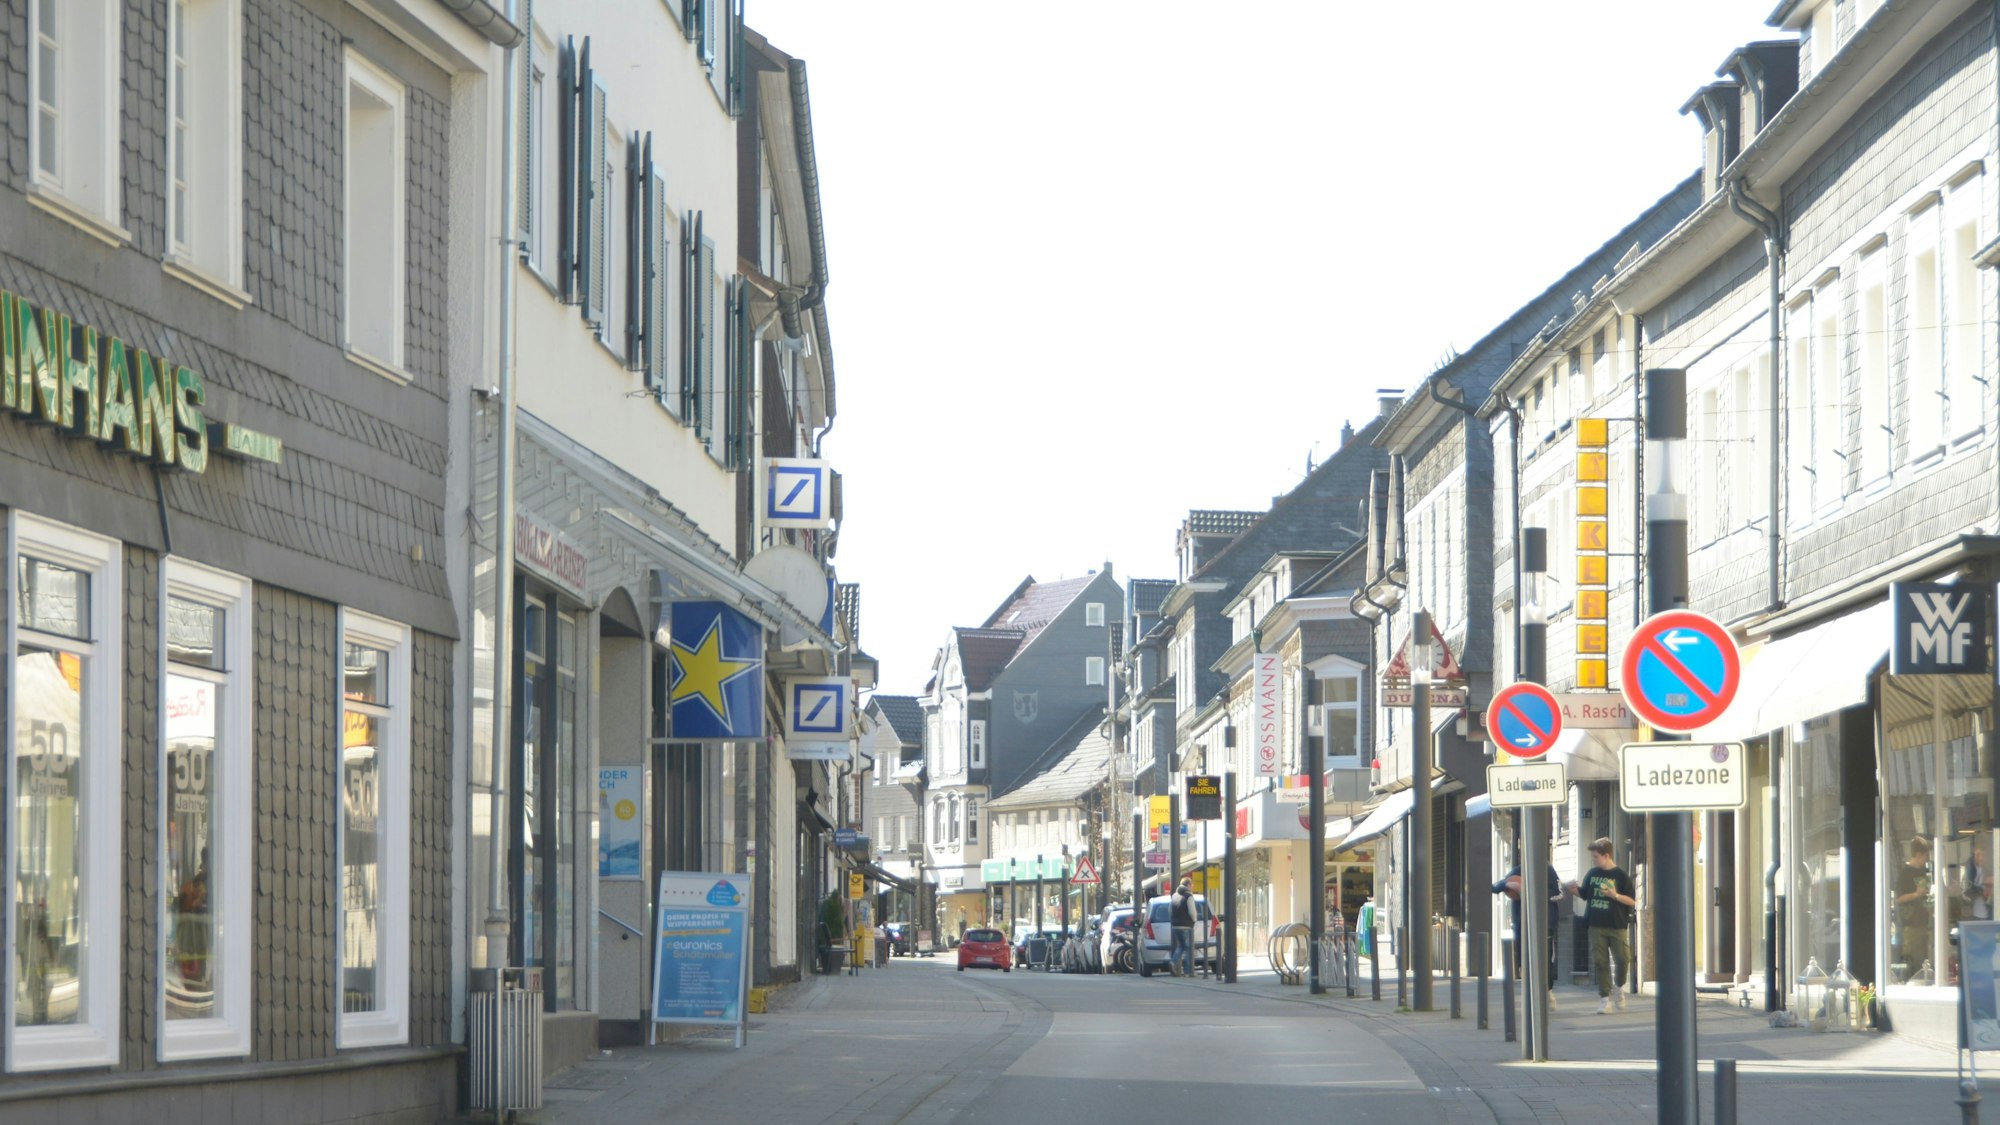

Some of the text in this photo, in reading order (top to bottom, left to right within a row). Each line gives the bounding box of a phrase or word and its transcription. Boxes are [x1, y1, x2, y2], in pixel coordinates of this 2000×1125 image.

[1582, 420, 1604, 687] ÄCKEREI
[1908, 592, 1971, 664] WMF
[1387, 694, 1462, 703] DUNA
[1260, 657, 1275, 773] ROSSMANN
[1562, 703, 1627, 719] A. Rasch
[30, 719, 68, 773] 50
[175, 743, 207, 791] 50
[1636, 764, 1730, 787] Ladezone
[31, 778, 67, 796] Jahre
[1189, 786, 1217, 795] FAHREN
[1197, 778, 1209, 787] SIE
[1497, 776, 1557, 792] Ladone
[176, 796, 206, 812] Jahre
[672, 940, 723, 951] euronics
